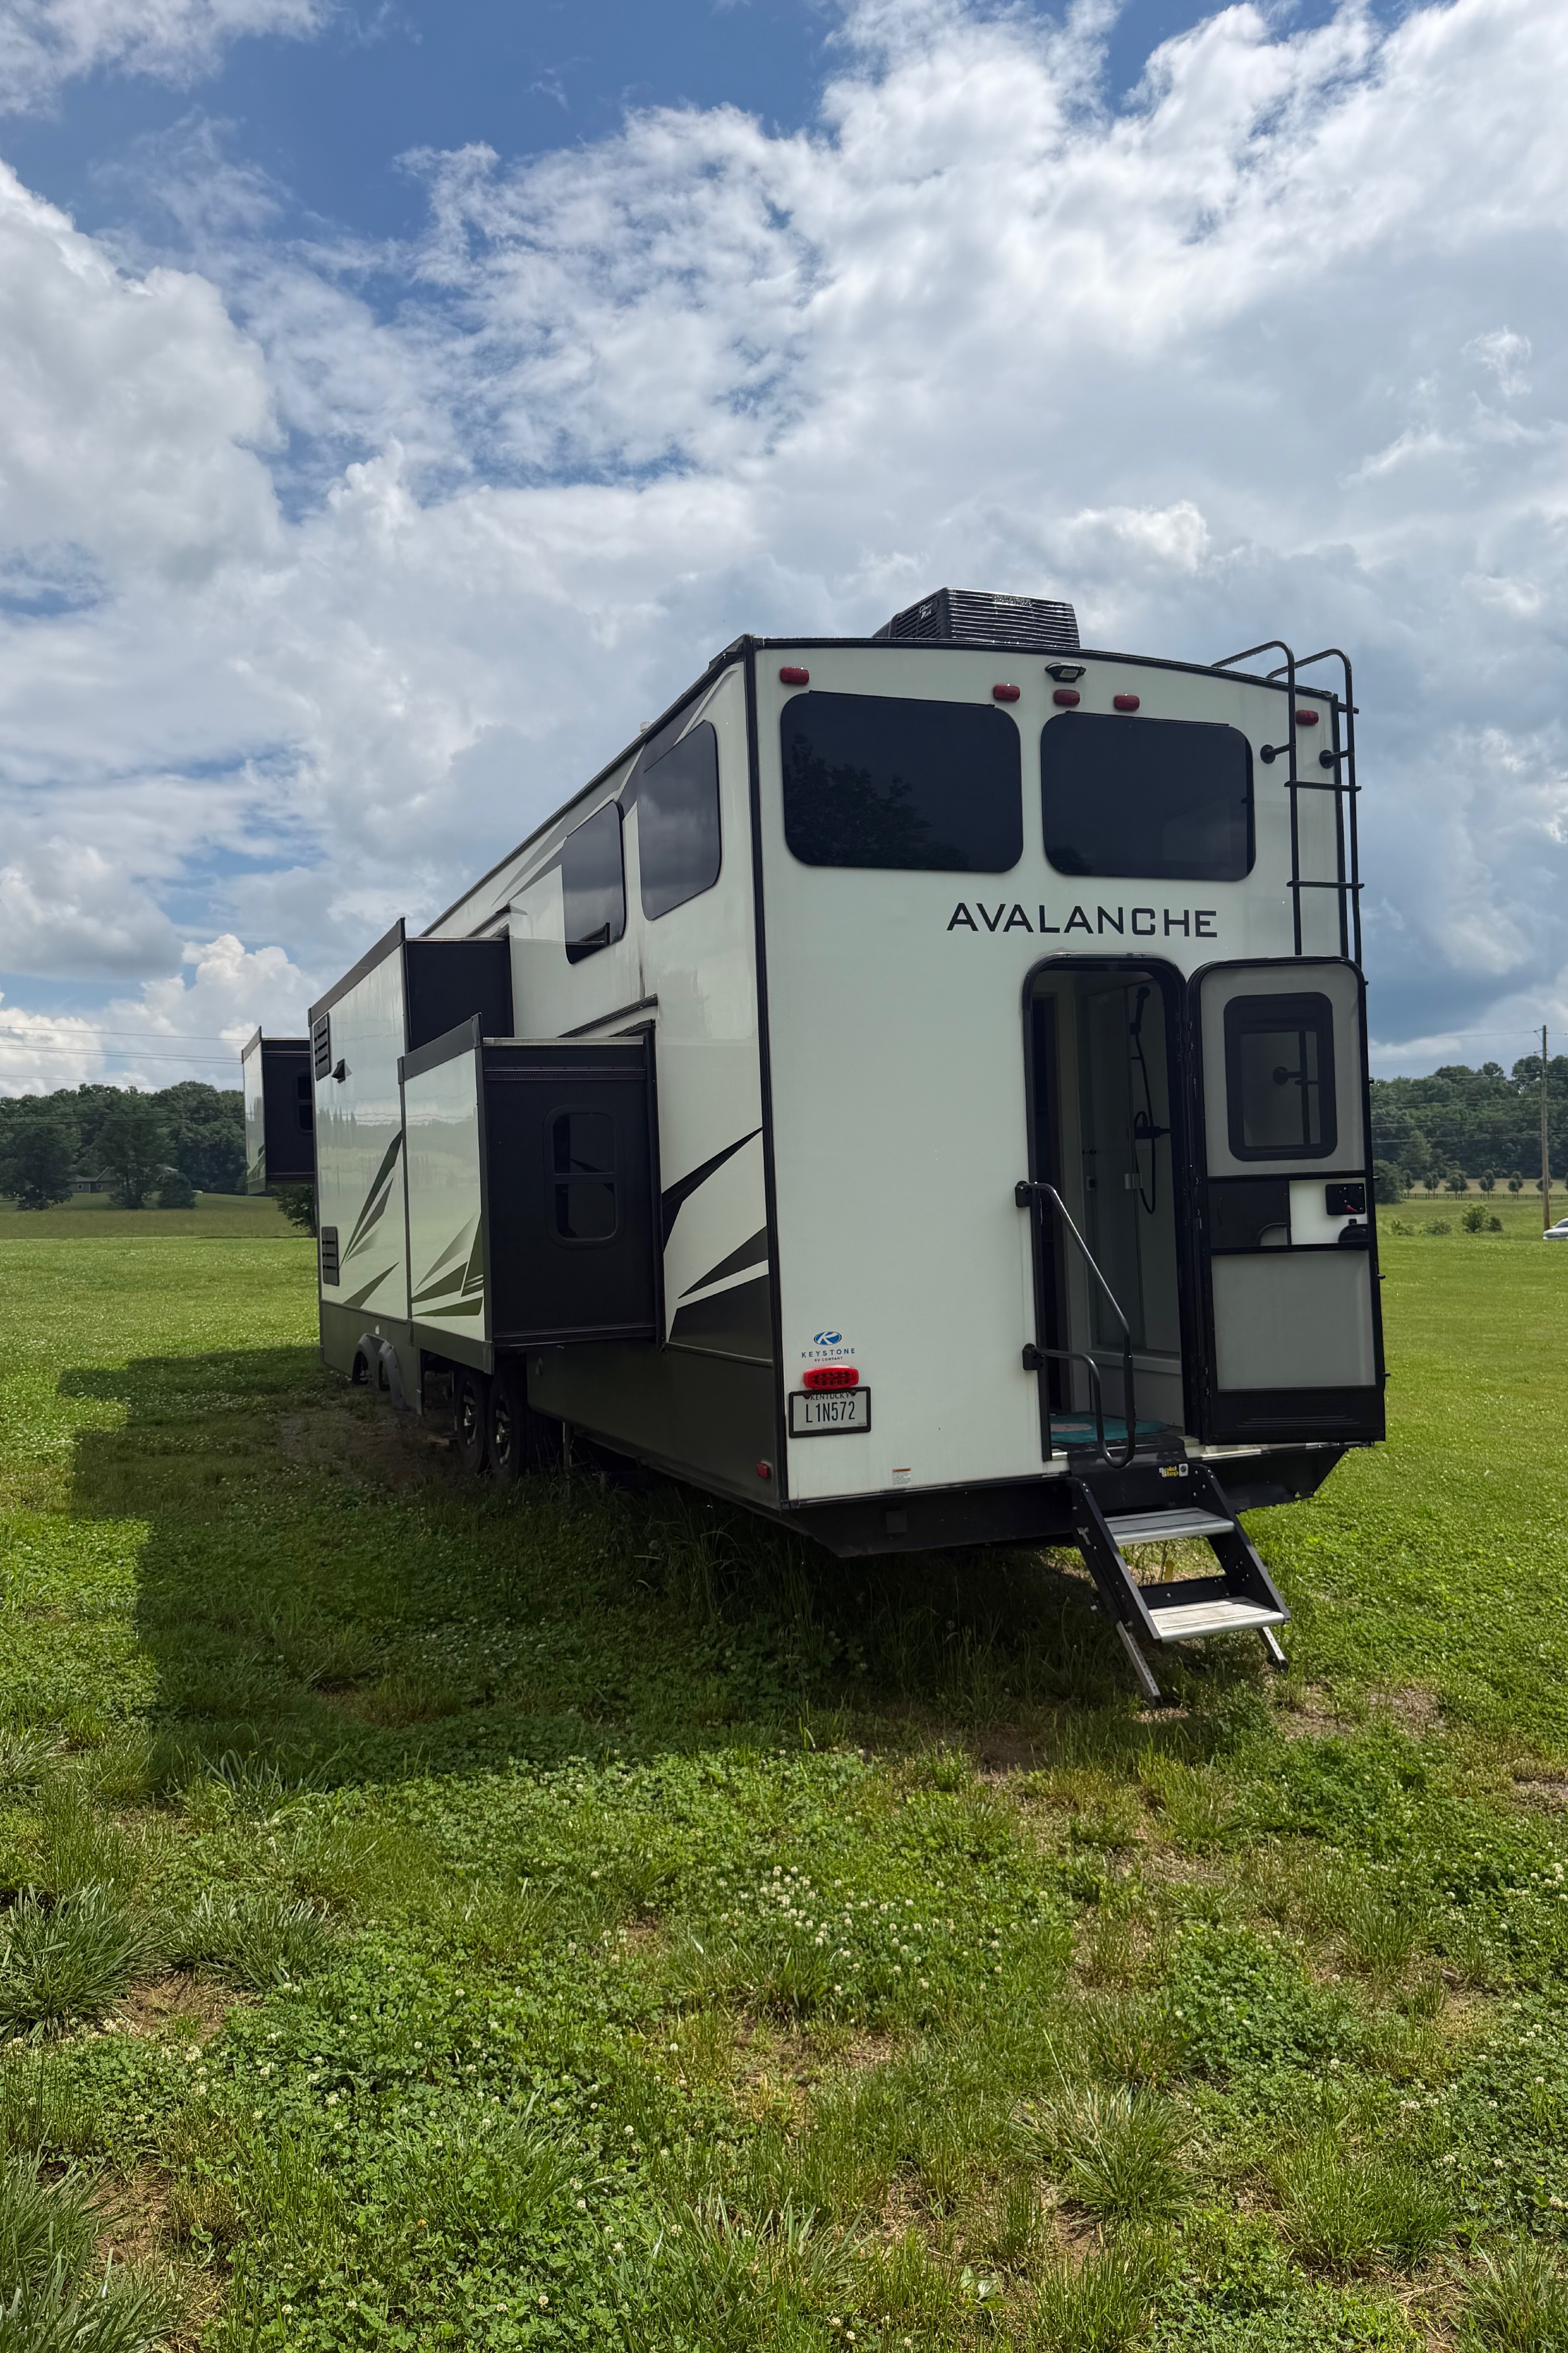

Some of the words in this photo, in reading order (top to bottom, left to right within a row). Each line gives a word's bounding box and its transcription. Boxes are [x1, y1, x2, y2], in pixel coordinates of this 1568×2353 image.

[946, 902, 1218, 938] AVALANCHE
[801, 1348, 855, 1358] KEYSTONE
[810, 1392, 850, 1401] KENTUCKY
[806, 1401, 855, 1423] L1N572
